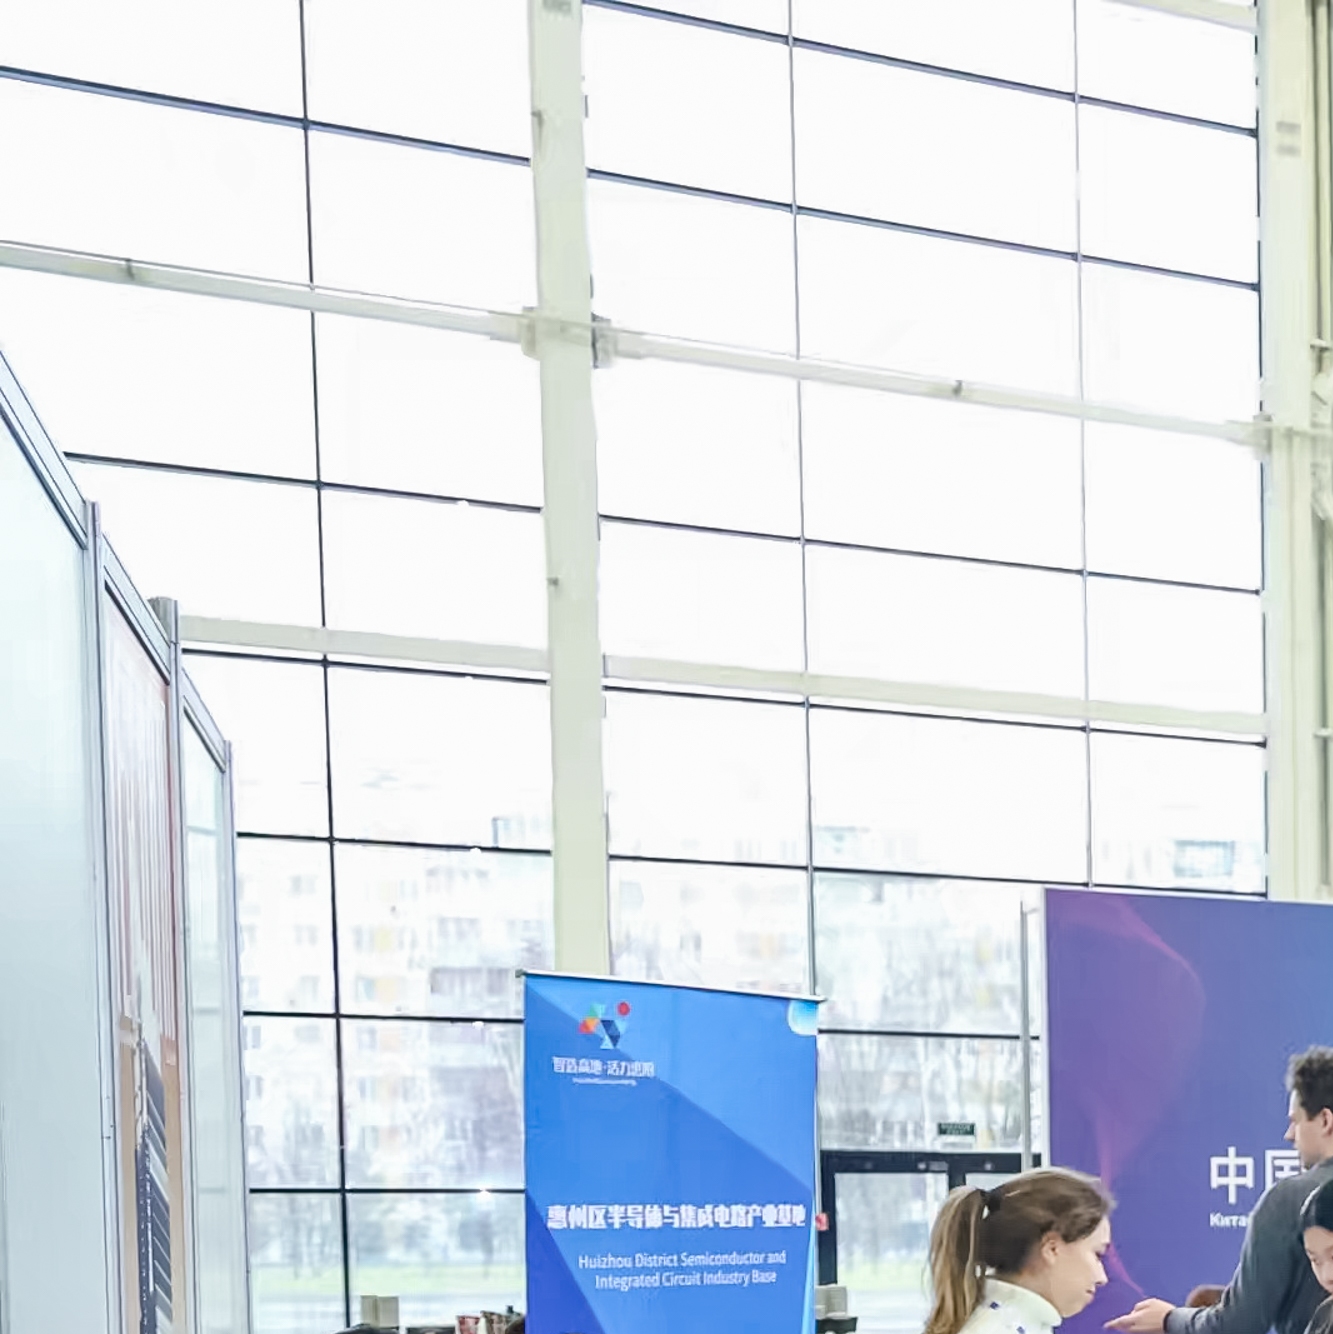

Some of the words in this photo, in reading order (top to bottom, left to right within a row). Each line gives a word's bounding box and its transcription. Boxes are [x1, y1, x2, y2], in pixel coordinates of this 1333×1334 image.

[578, 1254, 632, 1269] Huizhou
[634, 1252, 678, 1268] District
[680, 1251, 765, 1267] Semiconductor
[766, 1250, 787, 1265] and
[595, 1272, 661, 1292] Integrated
[662, 1270, 701, 1286] Circuit
[703, 1269, 750, 1287] Industry
[752, 1269, 777, 1284] Base
